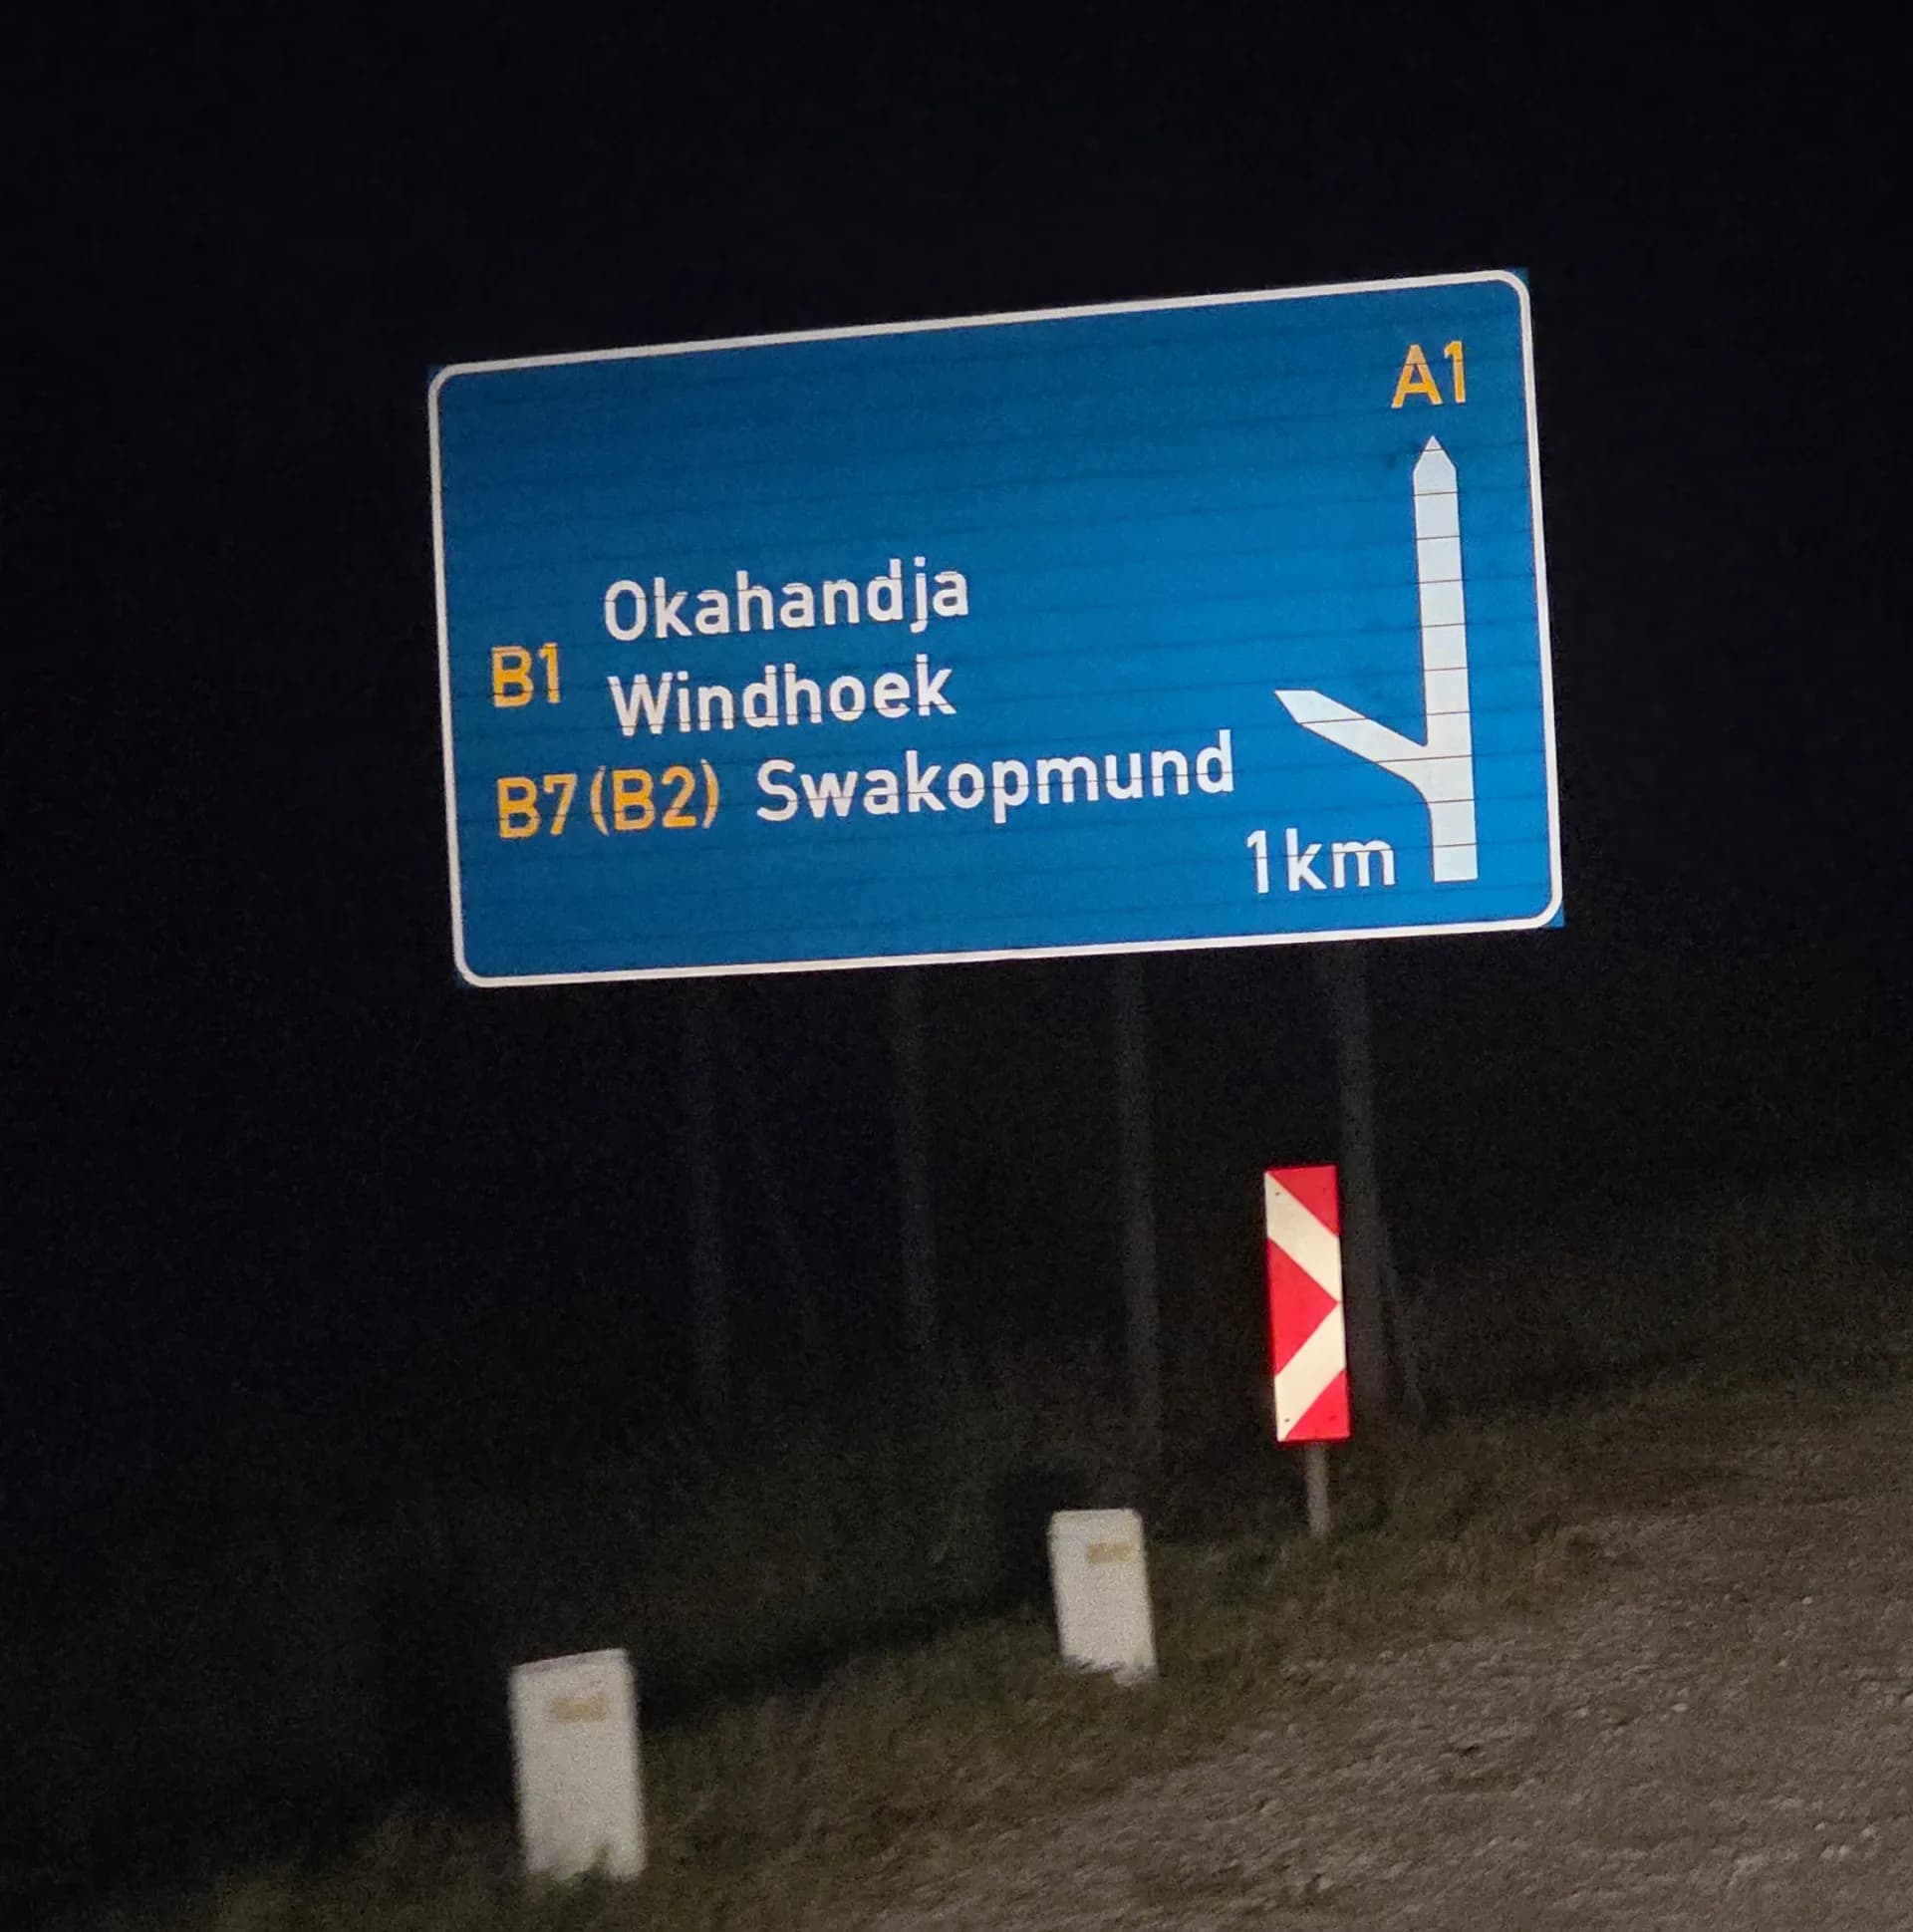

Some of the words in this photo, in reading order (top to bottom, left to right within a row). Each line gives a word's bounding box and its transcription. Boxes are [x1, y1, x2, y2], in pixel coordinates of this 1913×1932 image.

[1391, 340, 1467, 410] A1
[604, 556, 970, 642] Okahandja
[491, 642, 560, 708] B1
[607, 654, 957, 737] Windhoek
[497, 772, 578, 839] B7
[589, 758, 720, 836] (B2)
[756, 728, 1234, 829] Swakopmund
